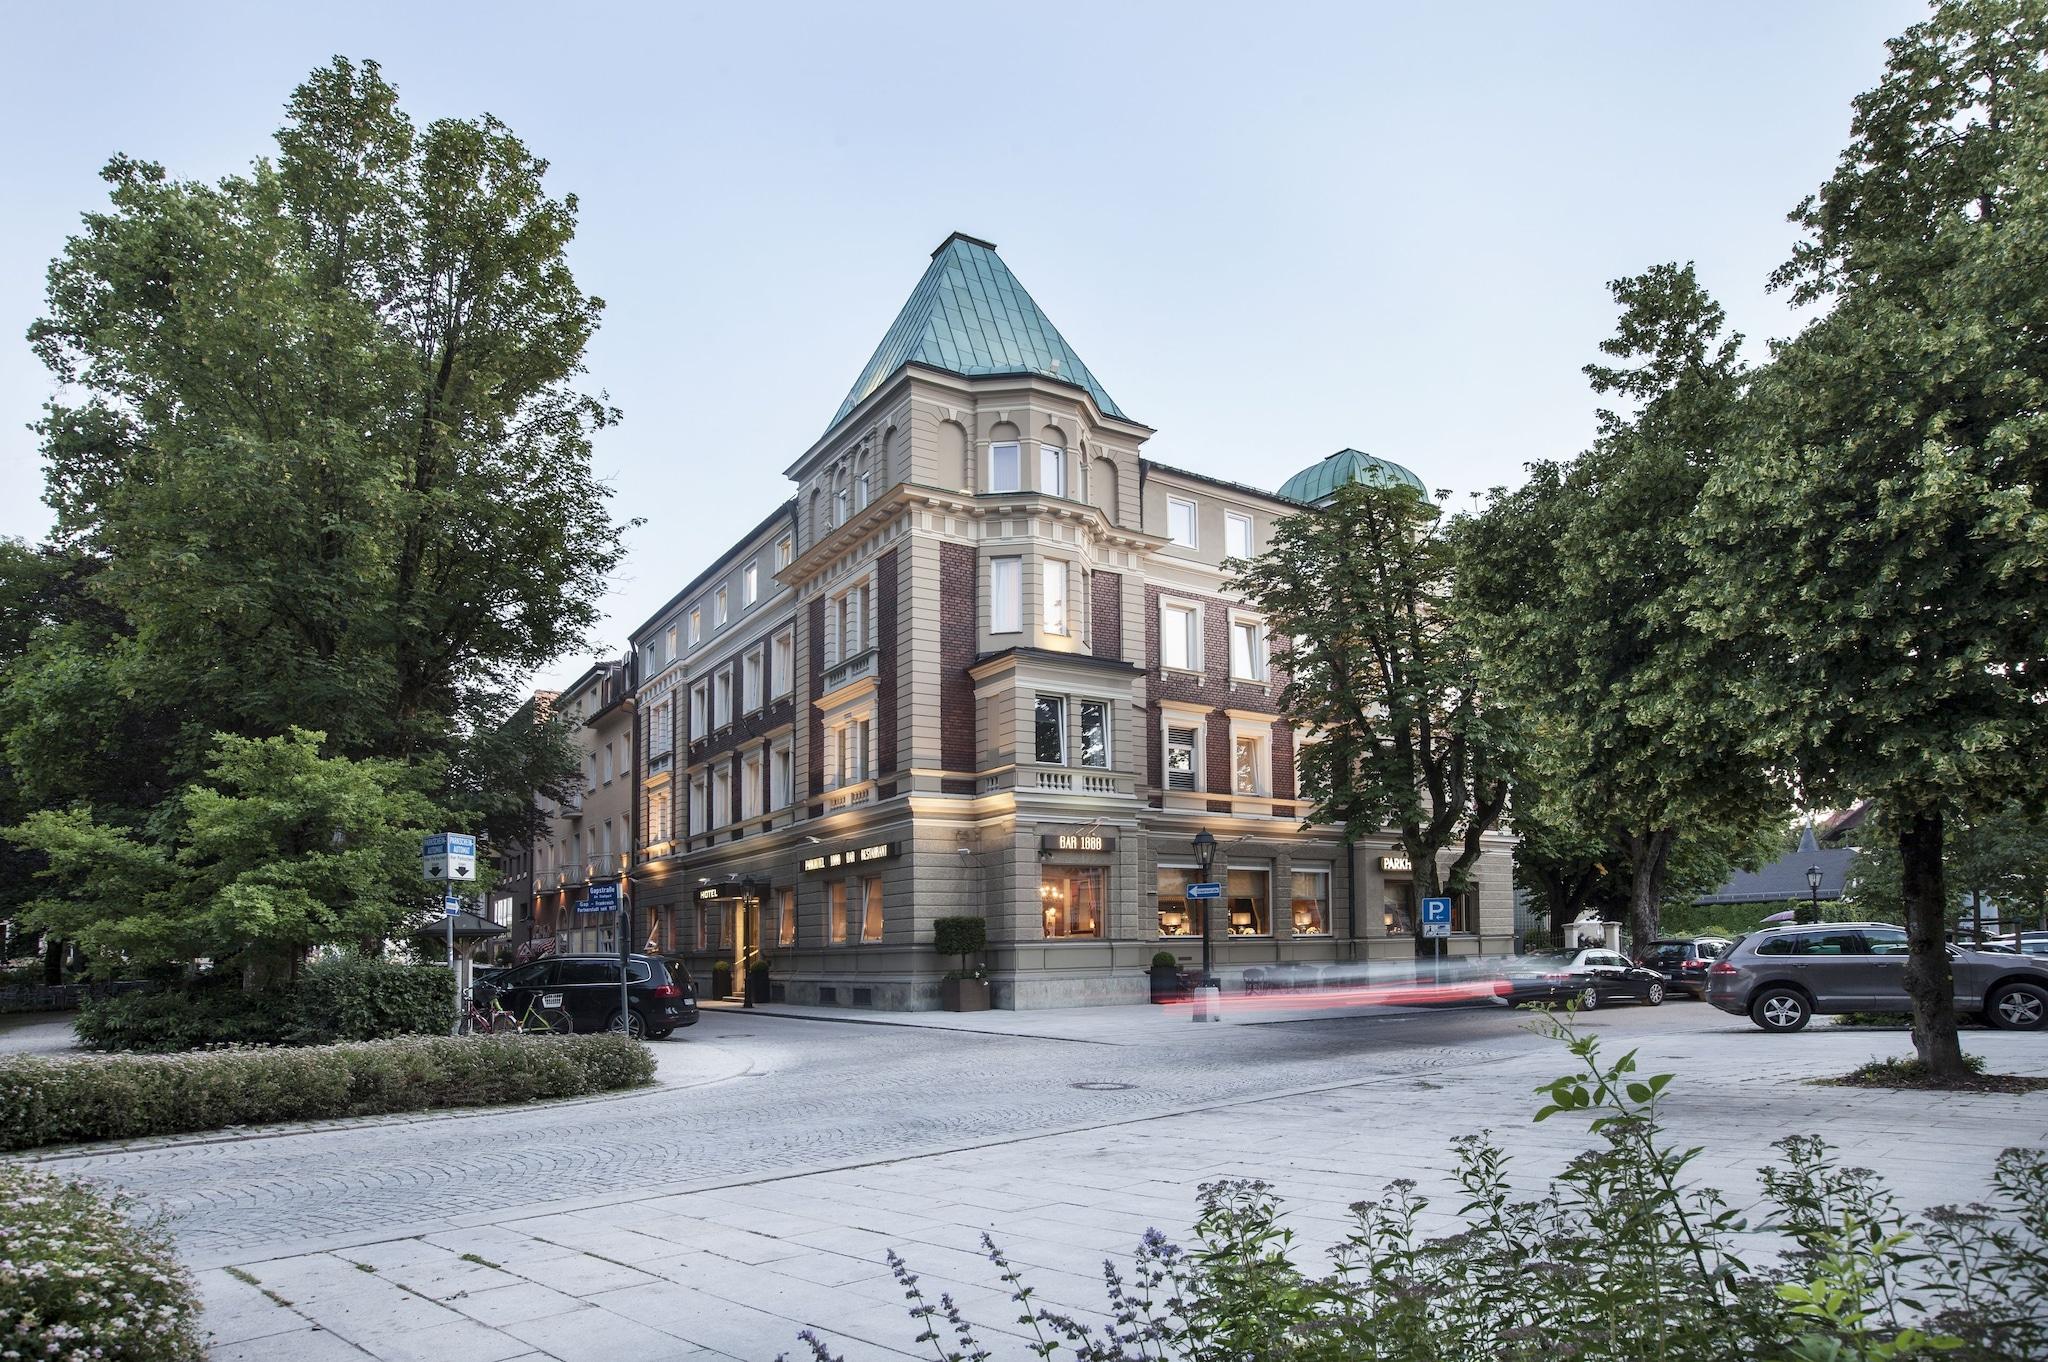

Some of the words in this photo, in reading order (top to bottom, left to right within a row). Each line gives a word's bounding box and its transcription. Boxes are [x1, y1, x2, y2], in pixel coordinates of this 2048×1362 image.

[1060, 836, 1077, 849] BAR
[1081, 837, 1102, 850] 1888
[861, 845, 888, 861] RESTAURANT
[590, 886, 615, 895] Gapstraße
[700, 889, 718, 899] HOTEL
[1429, 901, 1444, 920] P
